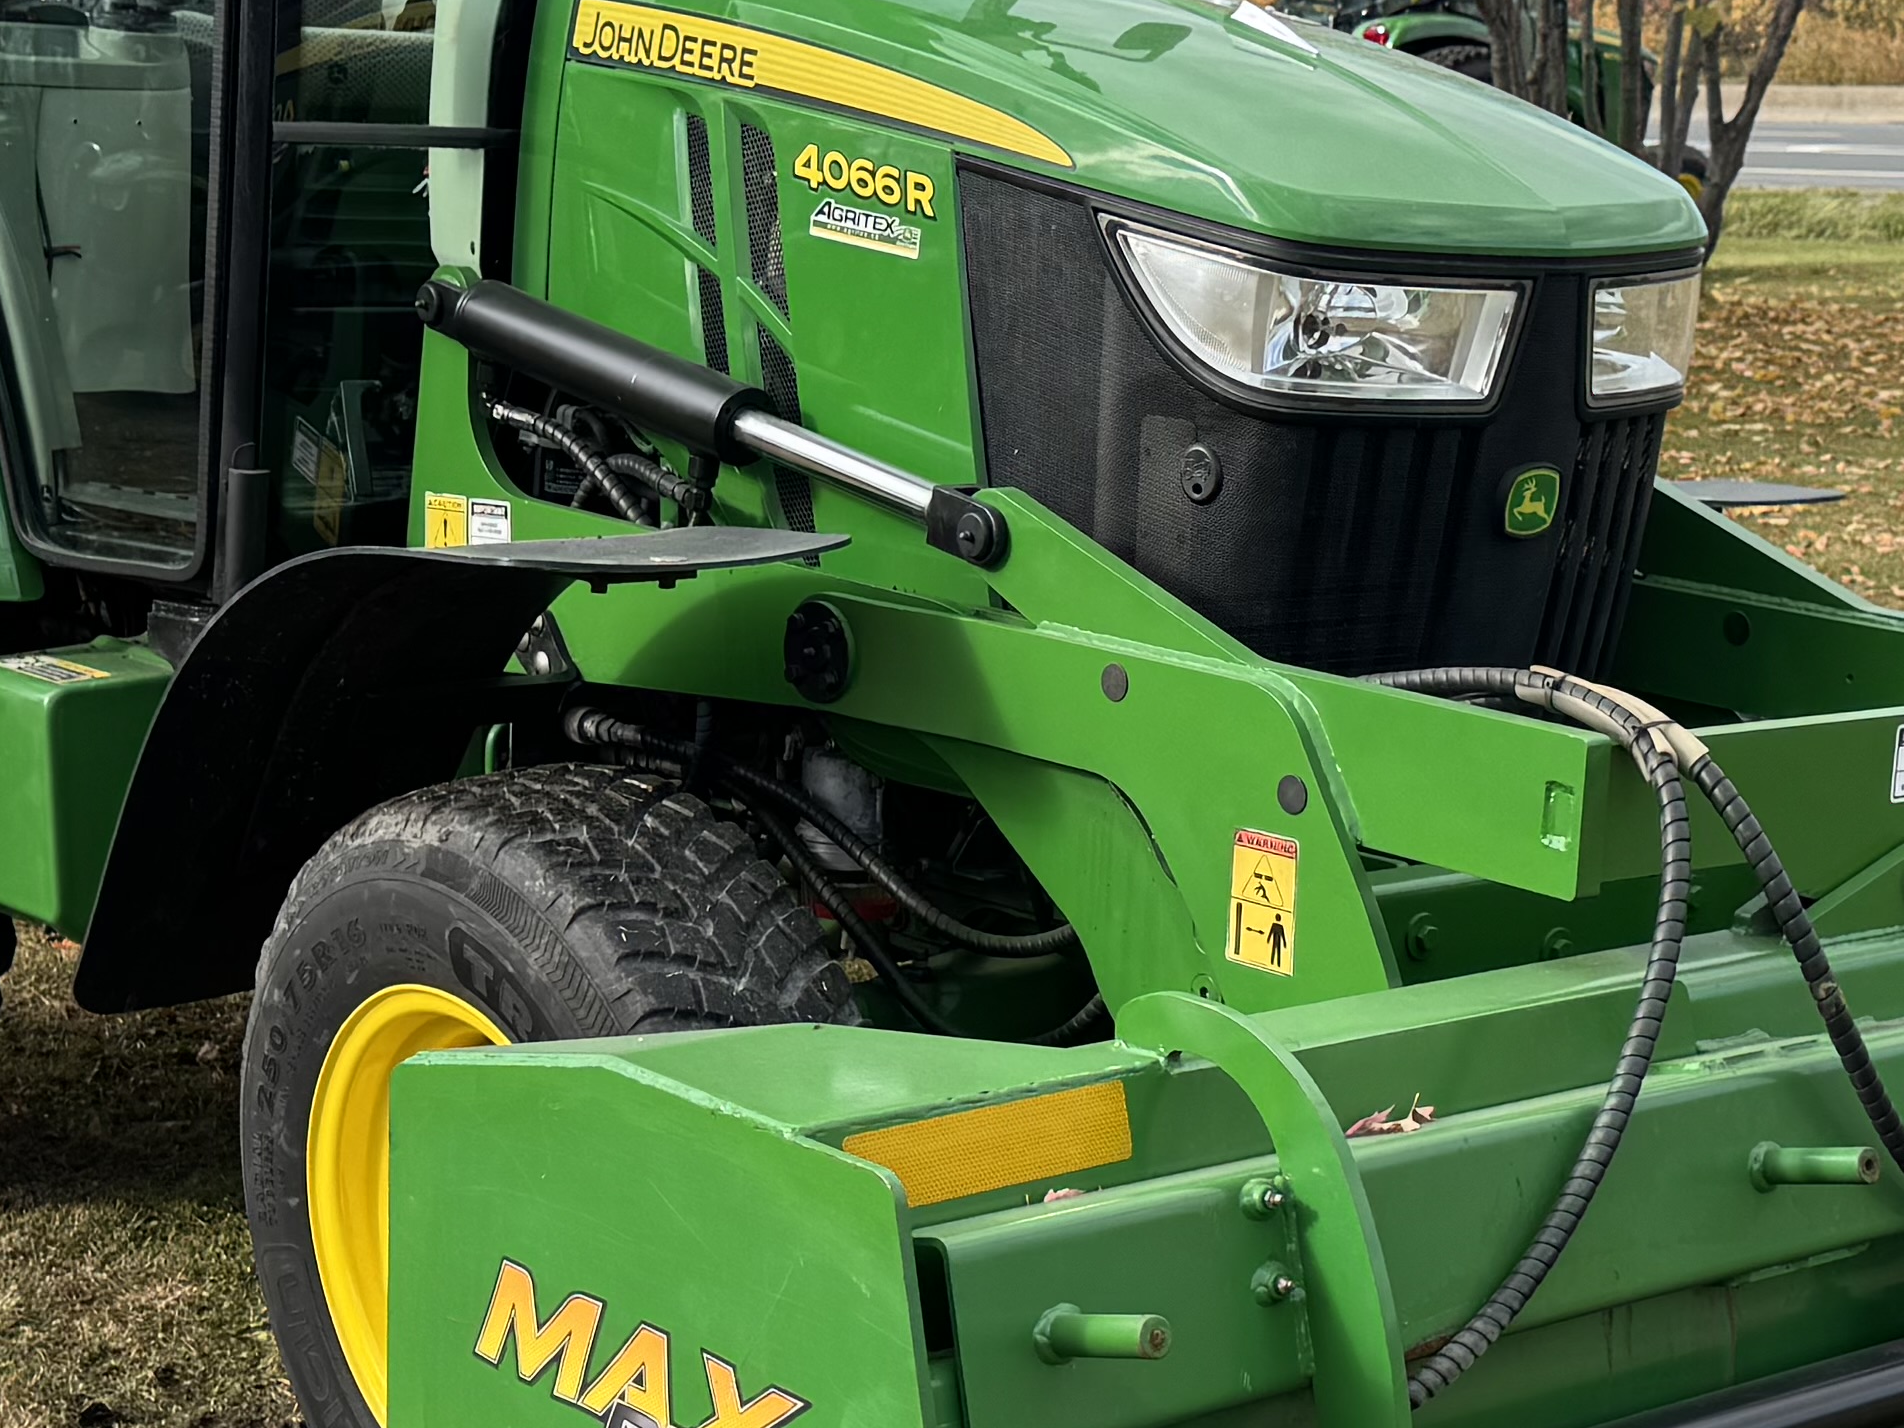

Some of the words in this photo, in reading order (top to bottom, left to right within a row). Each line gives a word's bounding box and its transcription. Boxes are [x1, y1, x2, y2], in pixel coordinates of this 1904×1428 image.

[582, 11, 655, 61] JOHN
[657, 22, 759, 82] DEERE
[814, 200, 897, 235] AGRITEX
[1247, 835, 1295, 854] WARNING
